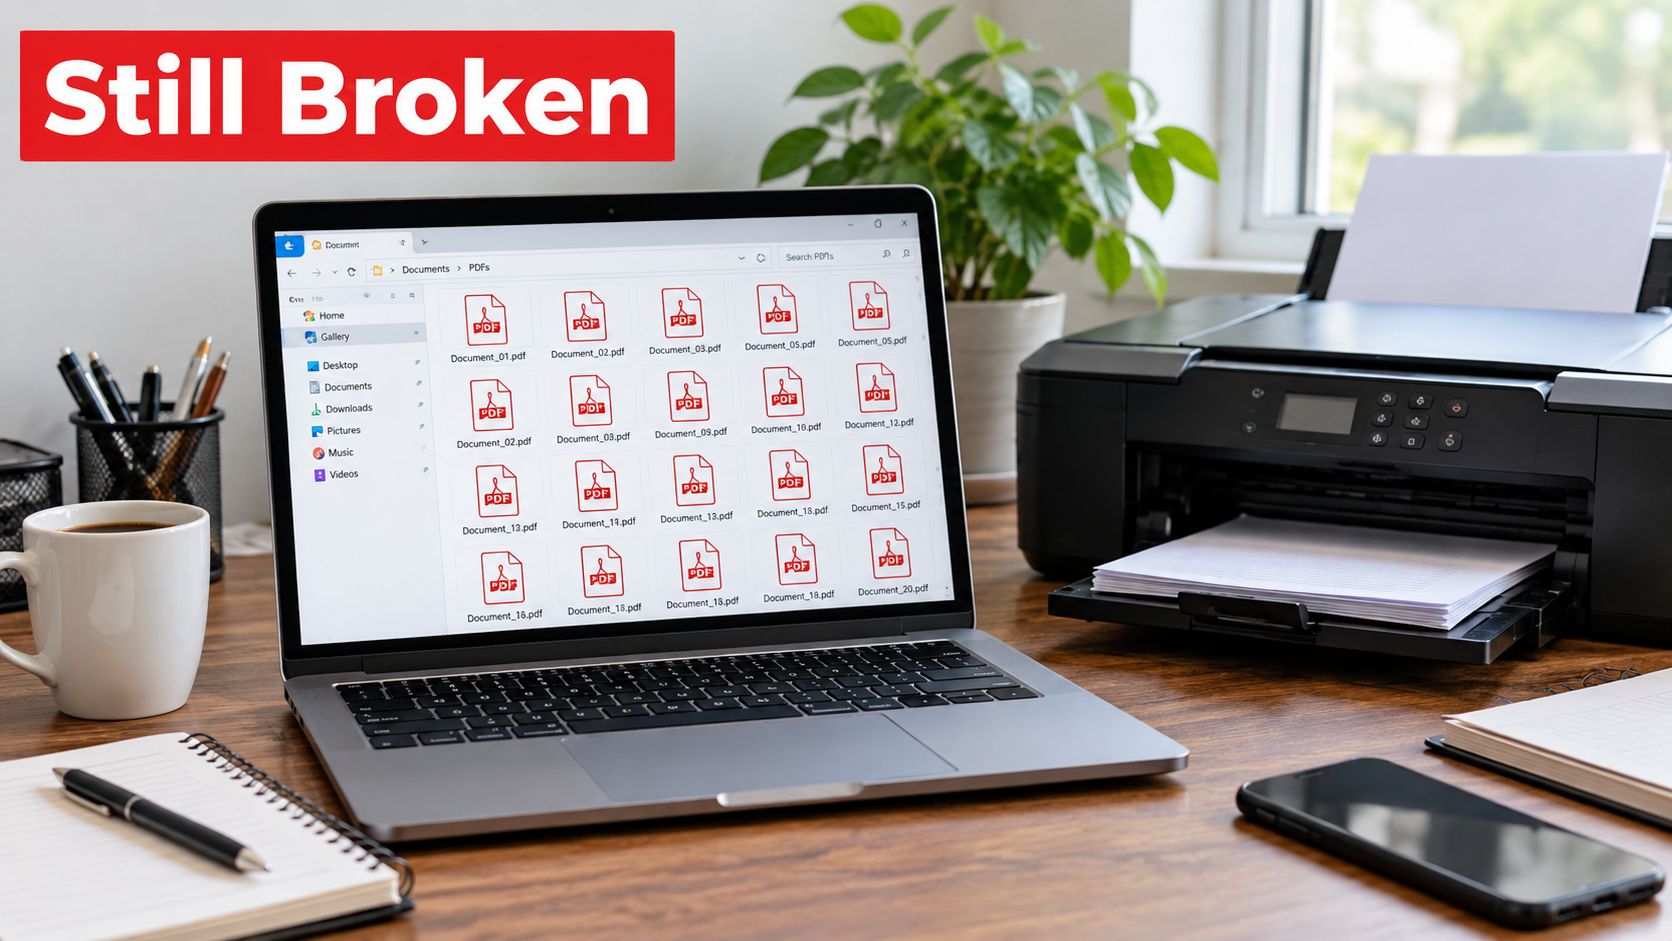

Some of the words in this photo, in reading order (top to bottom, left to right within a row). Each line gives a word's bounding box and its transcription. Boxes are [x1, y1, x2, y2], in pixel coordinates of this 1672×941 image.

[786, 252, 813, 261] Search
[402, 264, 450, 275] Documents
[468, 262, 490, 272] PDFs
[319, 311, 345, 320] Home
[321, 332, 350, 342] Gallery
[551, 347, 625, 359] Document_02.pdf
[649, 343, 722, 355] Document_03.pdf
[450, 351, 527, 363] Document_01.pdf
[323, 361, 358, 372] Desktop
[324, 382, 373, 392] Documents
[326, 403, 373, 413] Downloads
[844, 417, 915, 430] Document_12.pdf
[327, 426, 361, 435] Pictures
[456, 436, 532, 449] Document_02.pdf
[328, 448, 354, 457] Music
[329, 470, 359, 479] Videos
[778, 477, 803, 489] PDF
[485, 493, 512, 505] PDF
[857, 583, 929, 597] Document_20.pdf
